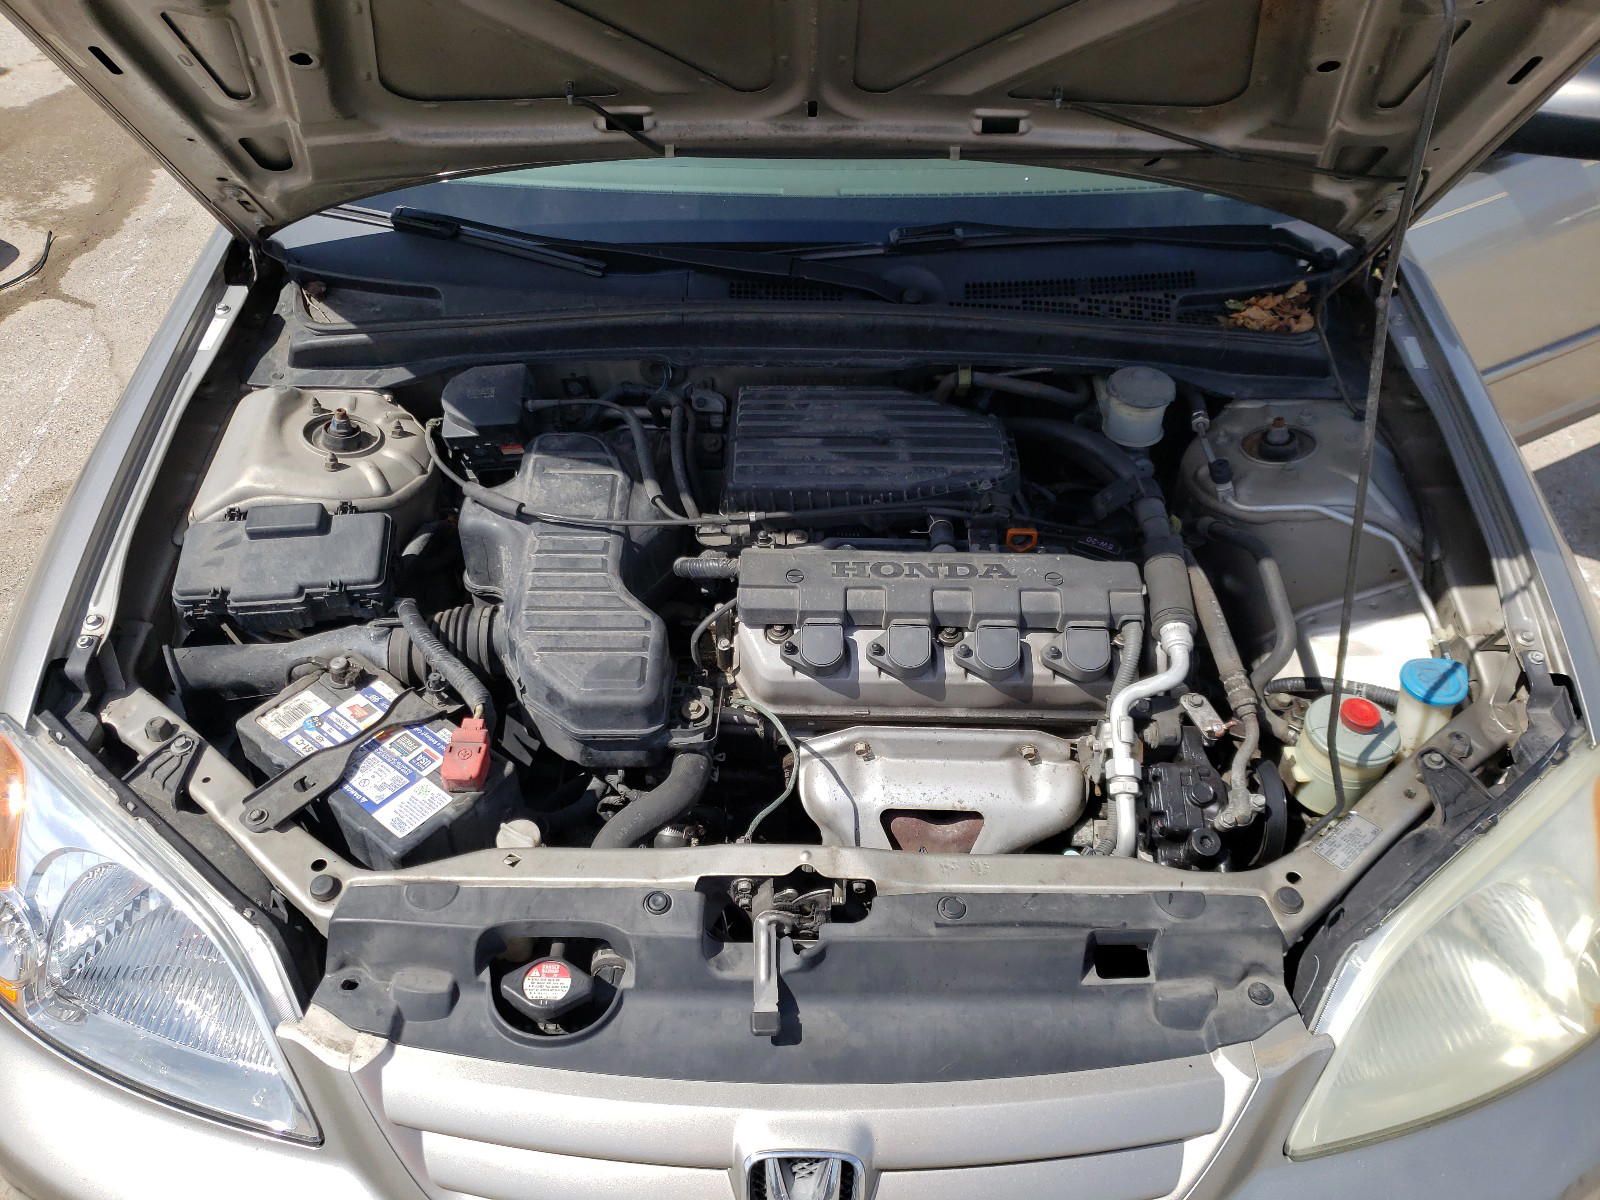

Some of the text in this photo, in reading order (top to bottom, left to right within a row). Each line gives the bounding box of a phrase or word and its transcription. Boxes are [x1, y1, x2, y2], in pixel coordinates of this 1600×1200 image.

[831, 561, 1018, 579] HONDA
[417, 754, 431, 767] USA
[343, 784, 363, 800] DANGE
